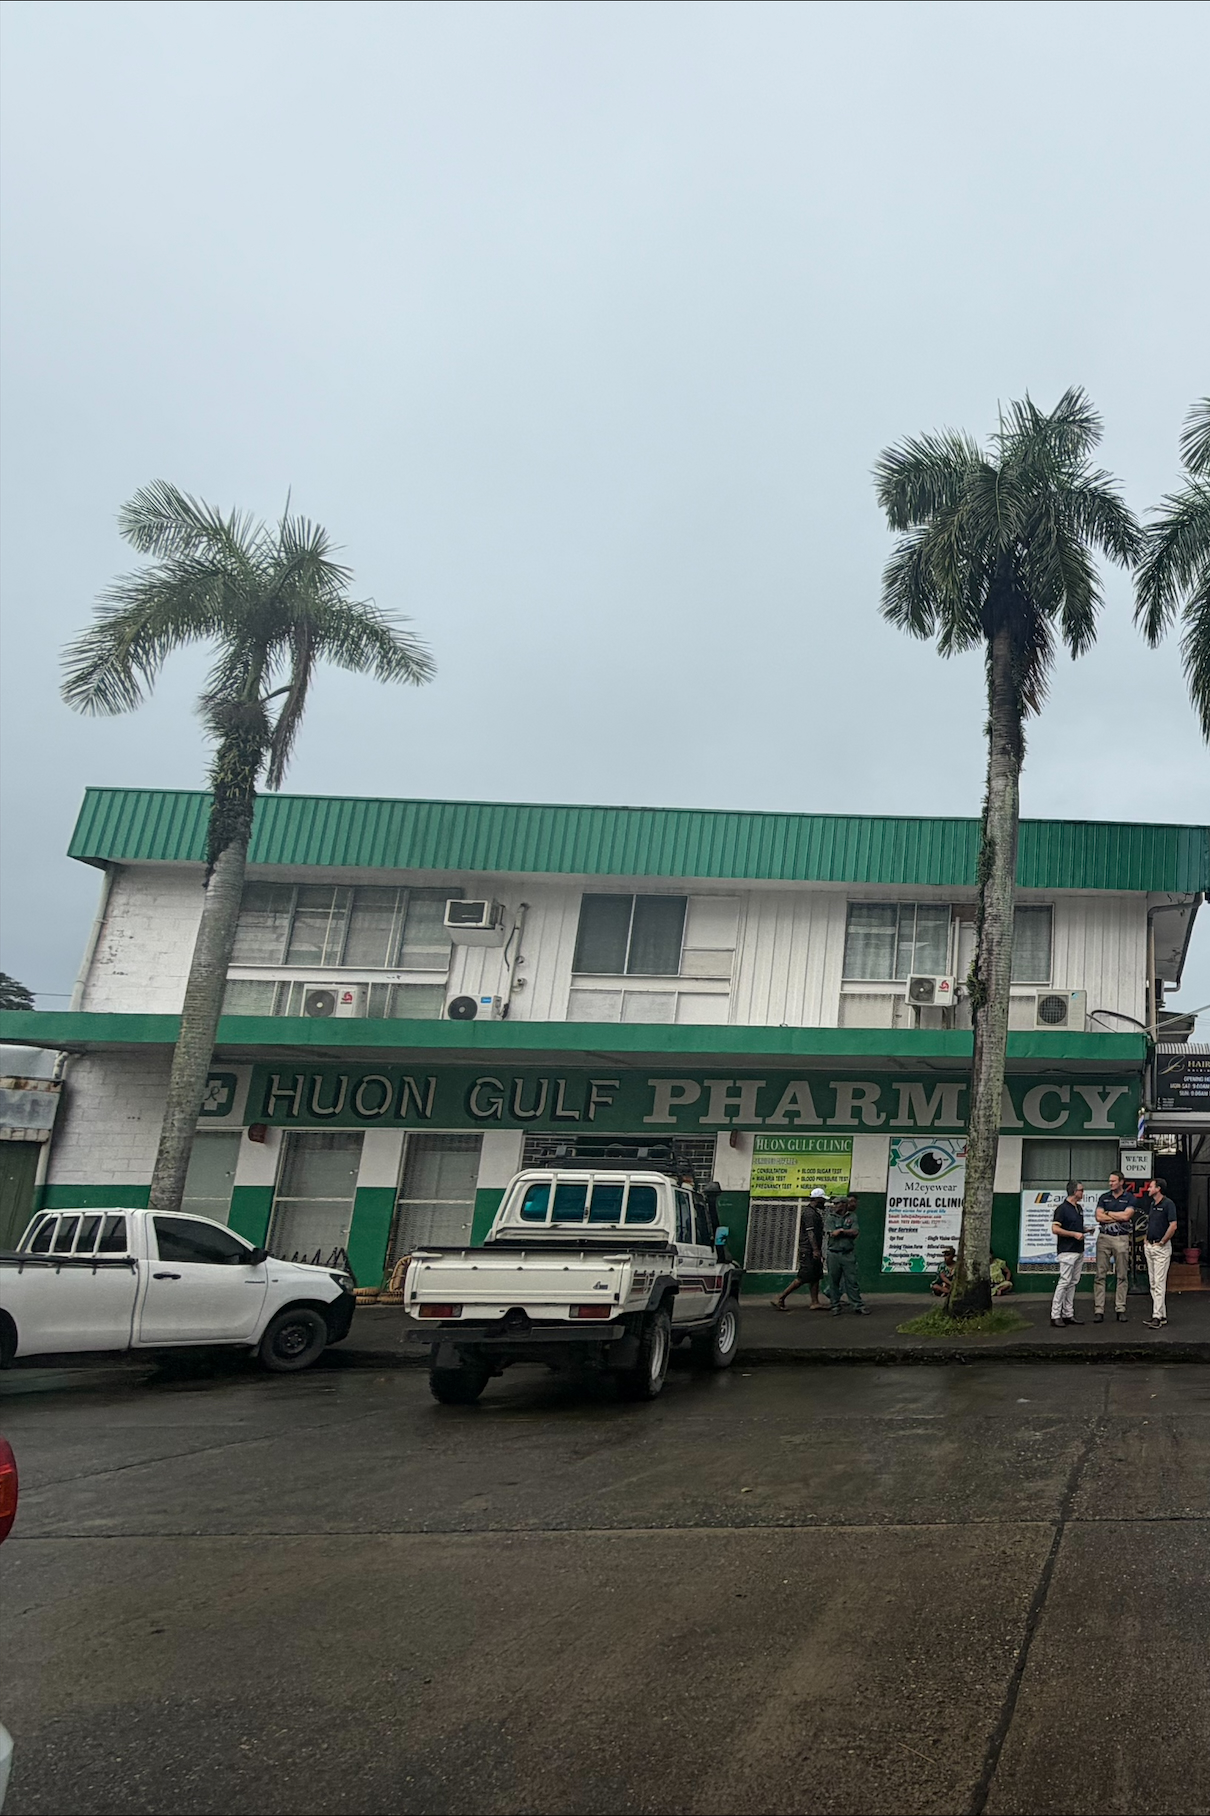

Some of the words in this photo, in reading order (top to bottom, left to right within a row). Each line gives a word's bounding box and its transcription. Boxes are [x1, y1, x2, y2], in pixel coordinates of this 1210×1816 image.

[1187, 1060, 1210, 1068] HAIR
[264, 1073, 437, 1120] HUON
[469, 1075, 620, 1122] GULF
[756, 1138, 785, 1150] HUON
[787, 1138, 816, 1151] GULF
[816, 1139, 852, 1152] CLINIC
[1125, 1155, 1148, 1163] WE'RE
[904, 1182, 957, 1195] M2eyewear
[889, 1197, 932, 1208] OPTICAL
[935, 1197, 963, 1208] CLINI
